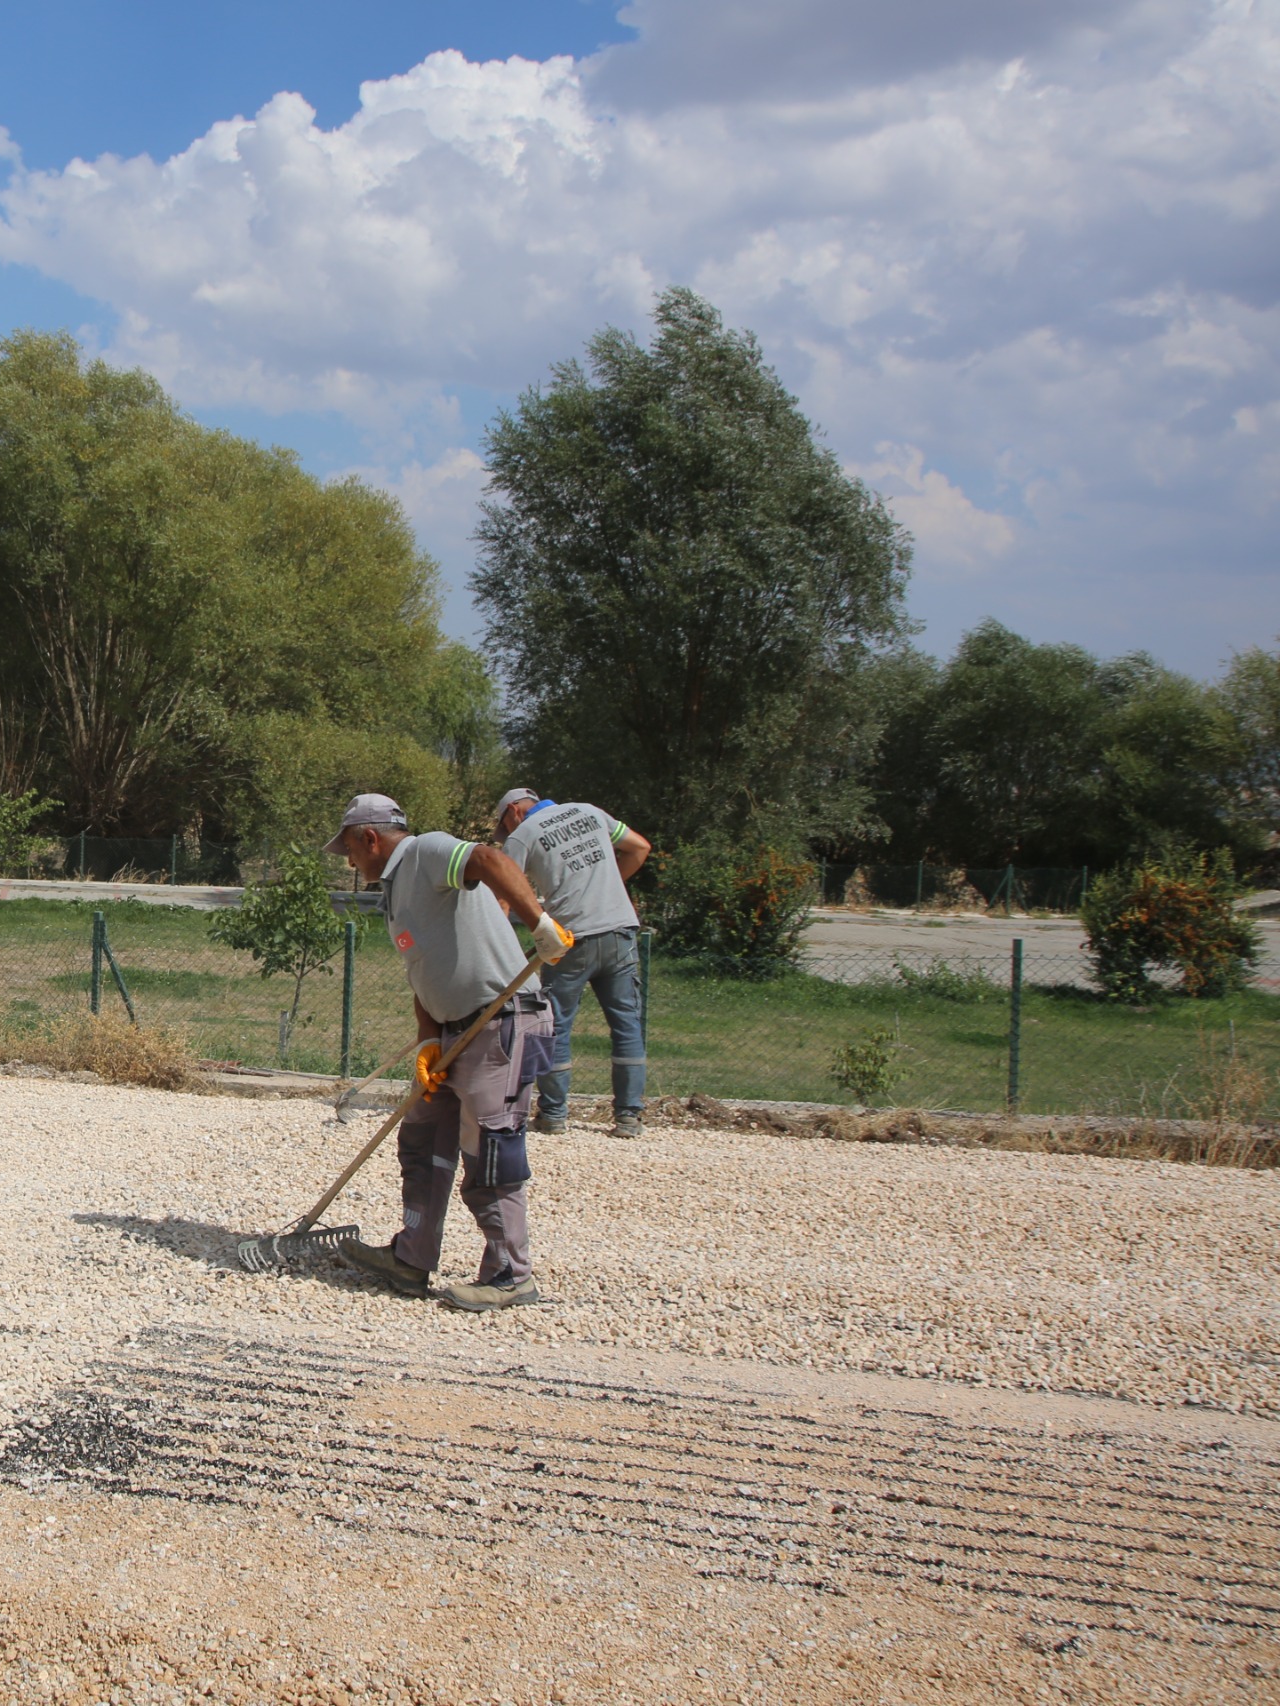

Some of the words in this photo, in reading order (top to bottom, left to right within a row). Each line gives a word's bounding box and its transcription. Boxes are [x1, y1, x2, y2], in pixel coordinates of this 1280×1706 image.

[539, 808, 581, 828] ESKİŞEHİR
[539, 813, 602, 852] BÜYÜKŞEHİR
[560, 836, 600, 860] BELEDİYESİ
[567, 859, 584, 872] YOL
[581, 846, 606, 869] İŞLERİ
